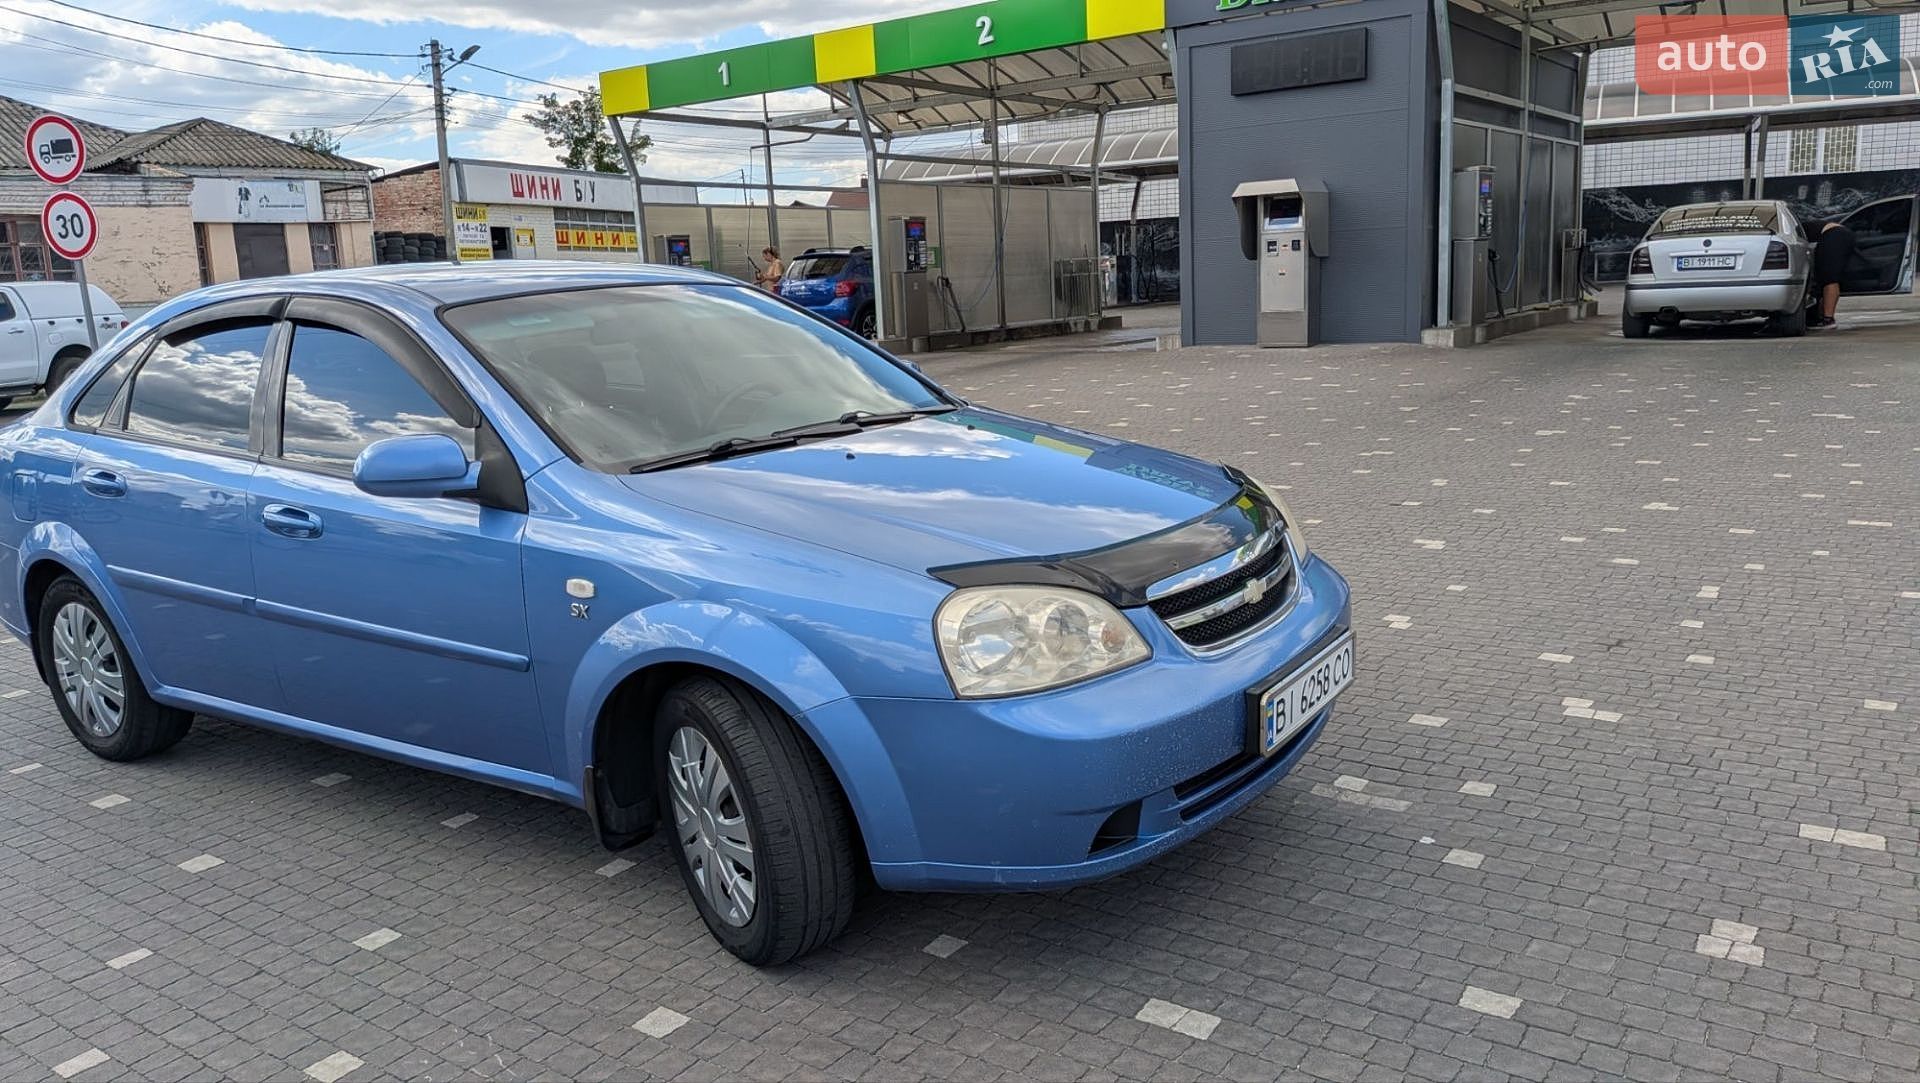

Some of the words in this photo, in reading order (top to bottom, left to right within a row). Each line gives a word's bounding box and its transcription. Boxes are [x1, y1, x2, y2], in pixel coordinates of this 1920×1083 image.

[975, 15, 995, 46] 2
[717, 61, 730, 87] 1
[510, 172, 562, 201] ШИНИ
[573, 179, 595, 203] Б/У
[55, 212, 84, 240] 30
[555, 230, 621, 246] ШИНИ
[570, 602, 589, 619] SX
[1275, 690, 1294, 734] BI
[1300, 663, 1330, 714] 6258
[1333, 647, 1350, 686] CO
